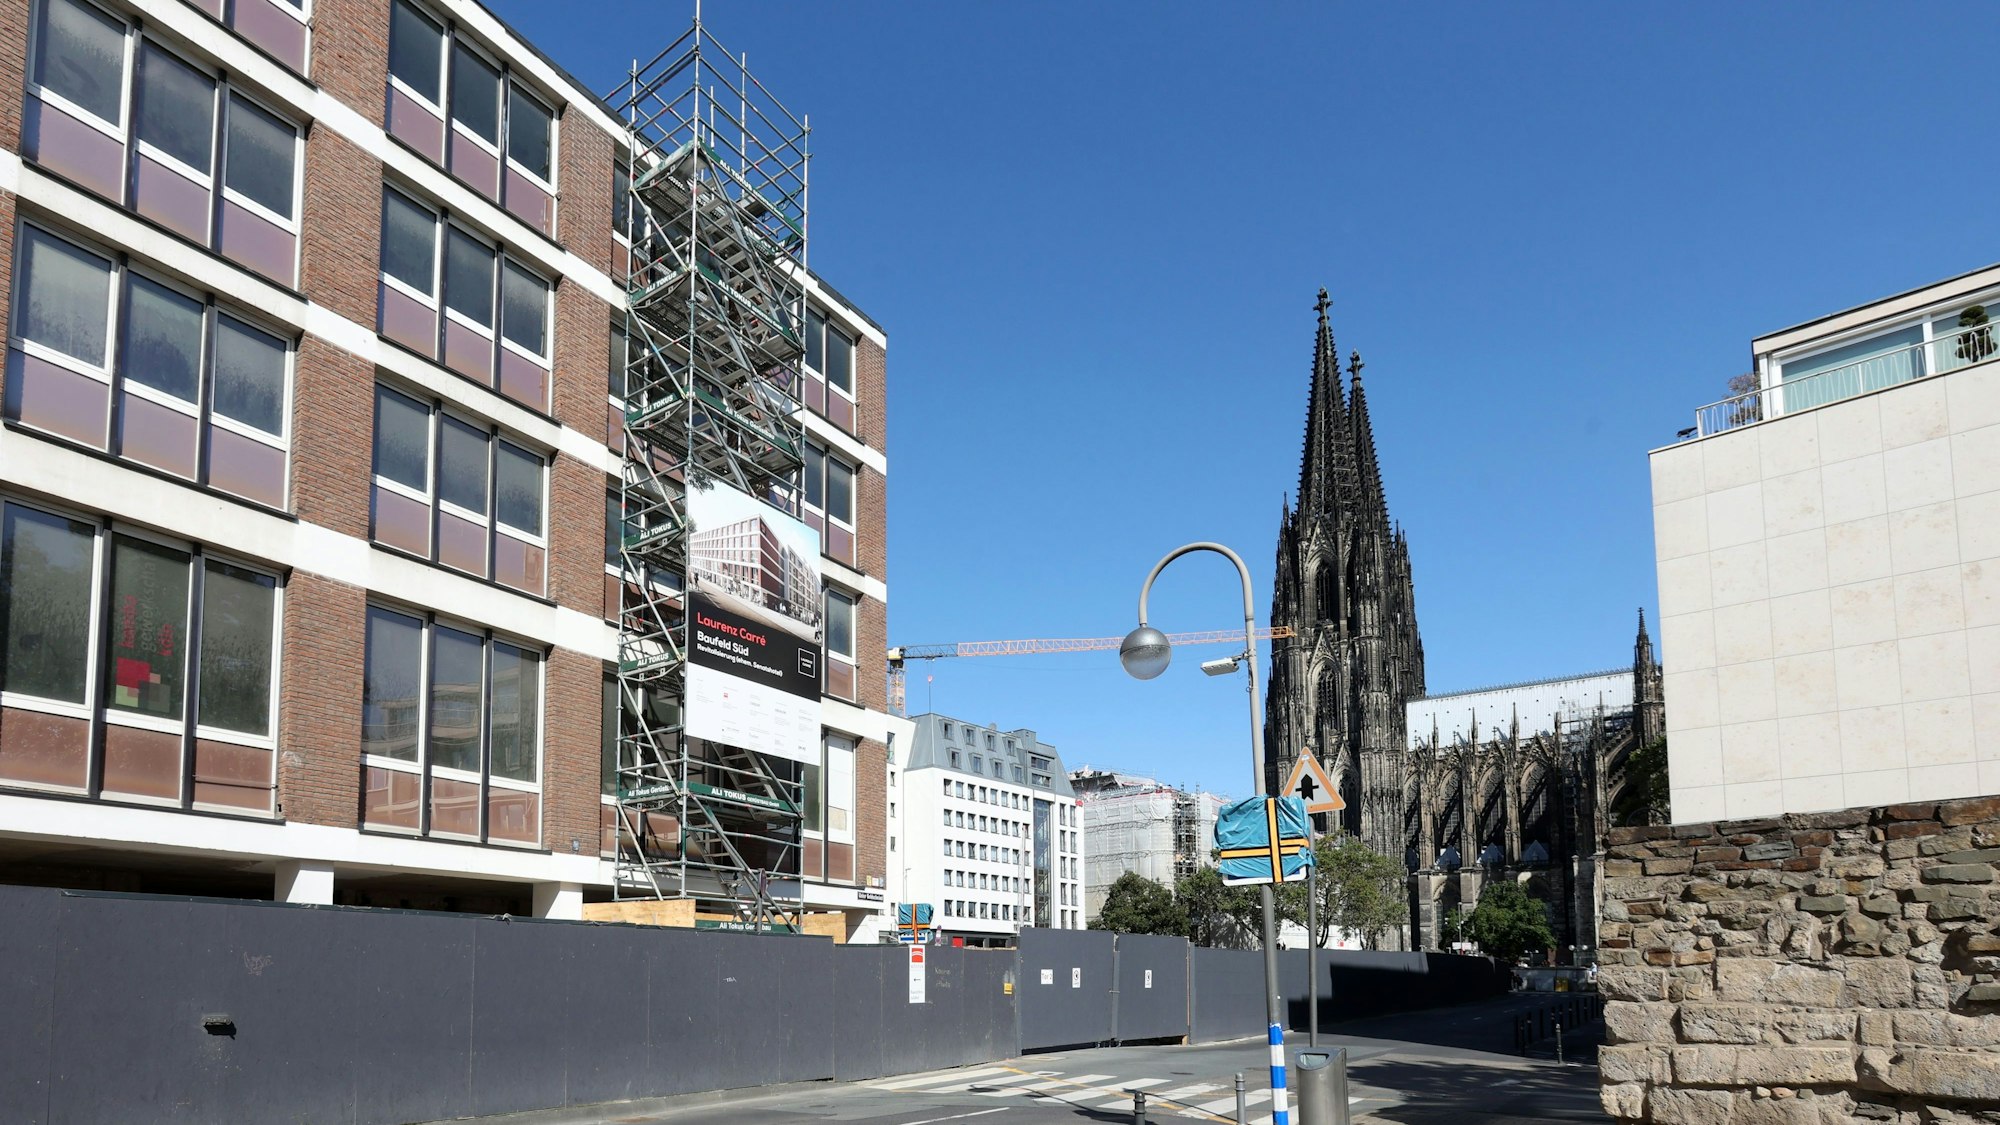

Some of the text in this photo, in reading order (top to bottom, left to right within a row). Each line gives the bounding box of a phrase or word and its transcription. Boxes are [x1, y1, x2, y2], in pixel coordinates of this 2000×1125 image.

[718, 279, 752, 308] ALI TOKUS
[652, 394, 674, 410] TOKUS
[640, 522, 672, 540] ALI TOKUS
[697, 612, 767, 647] Laurenz Carré
[697, 630, 750, 657] Baufeld Süd
[648, 652, 669, 664] TOKUS
[697, 643, 736, 663] Revitalisierung
[635, 788, 650, 796] Tokus
[711, 787, 723, 796] ALI
[723, 790, 747, 801] TOKUS
[727, 922, 744, 930] Tokus
